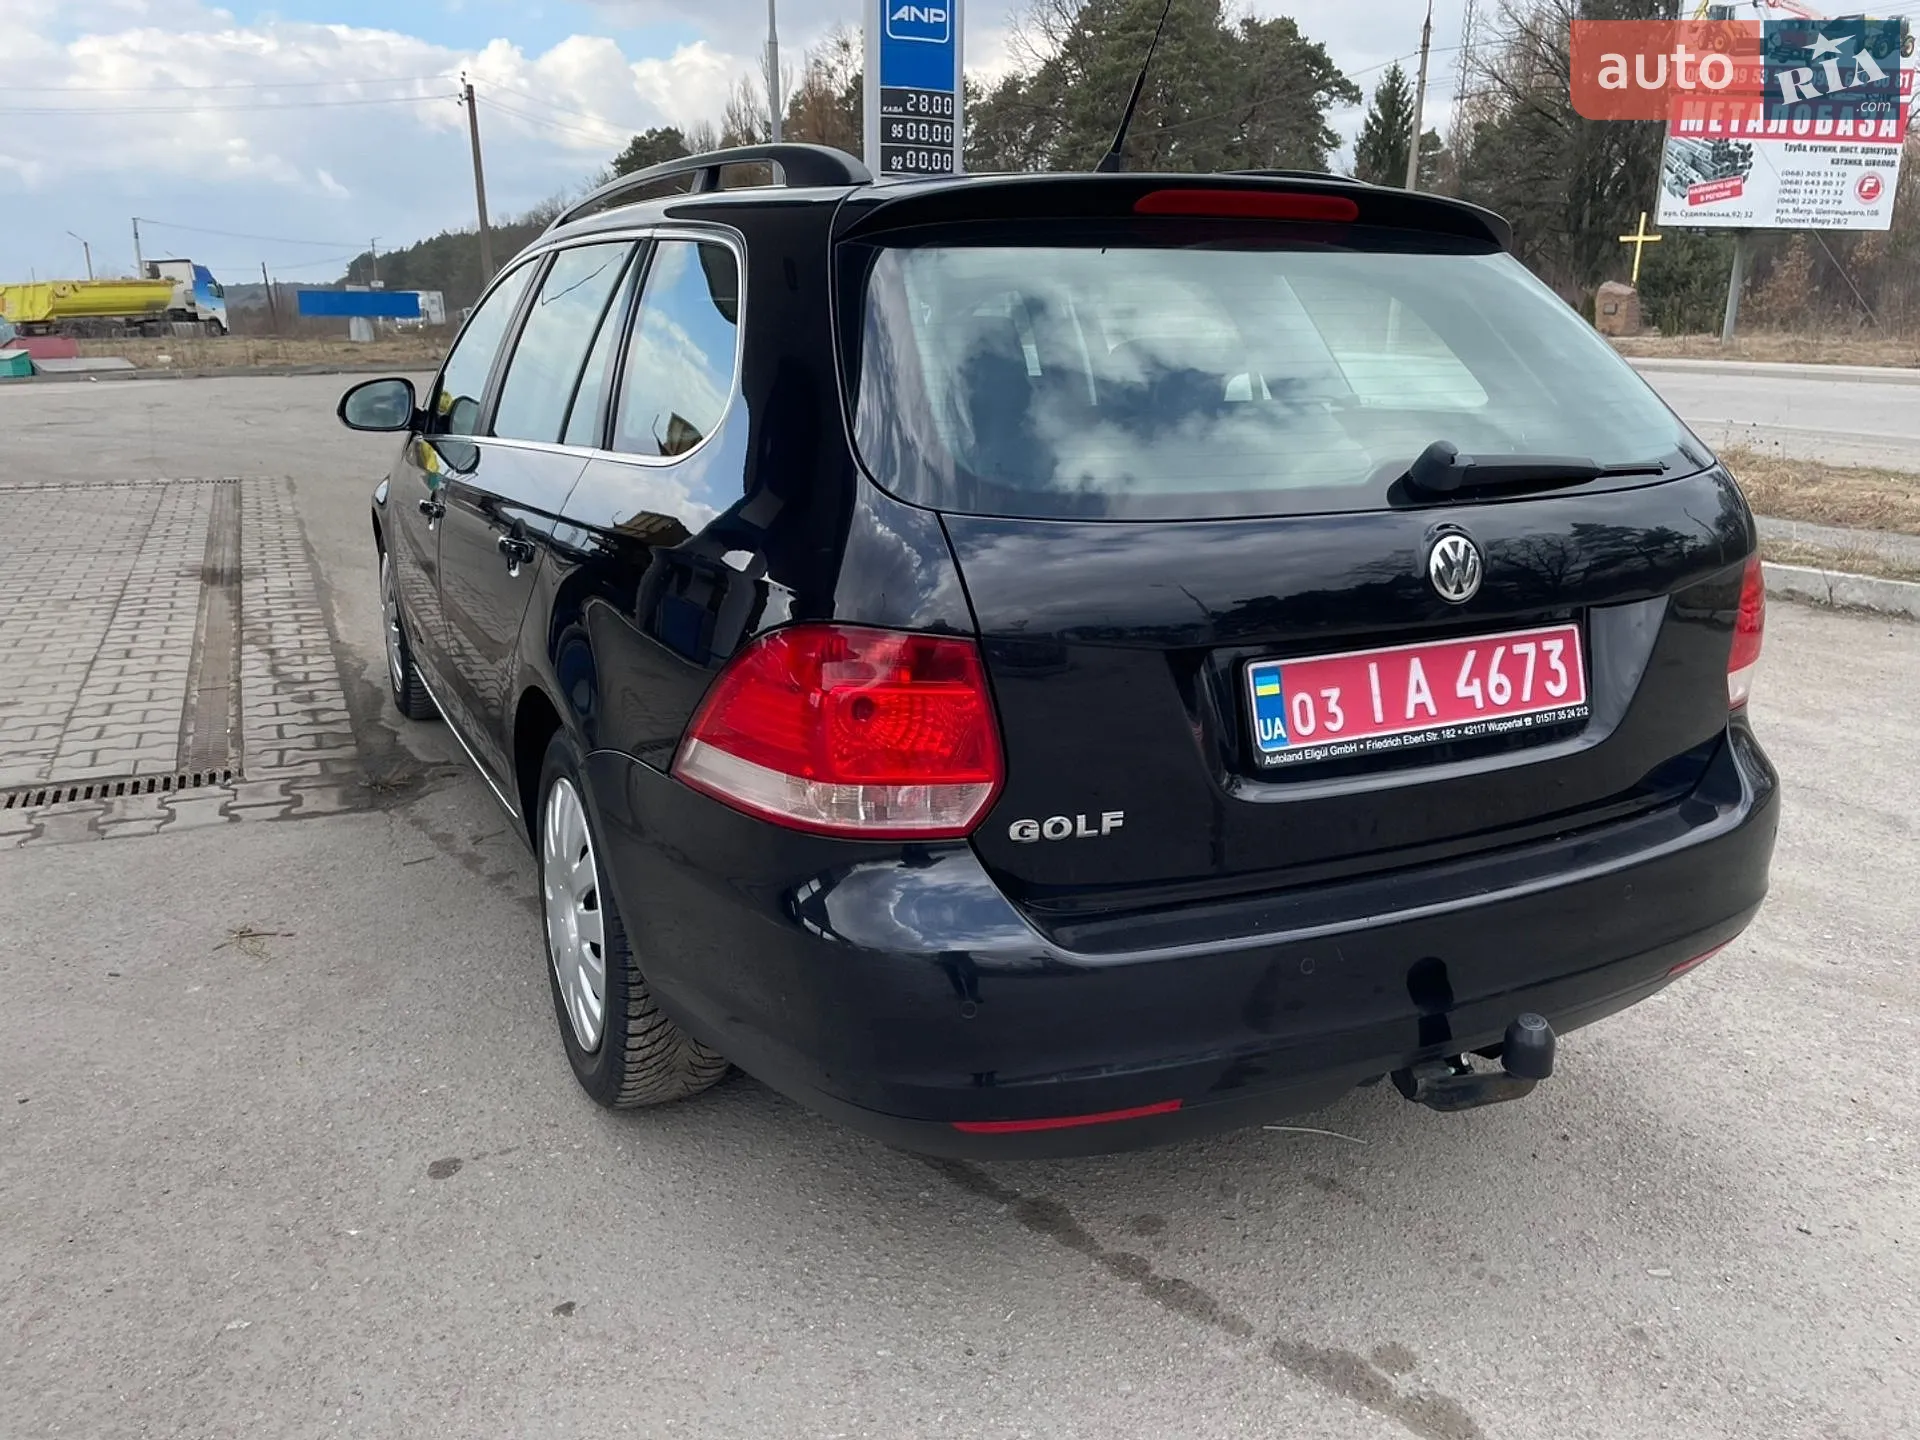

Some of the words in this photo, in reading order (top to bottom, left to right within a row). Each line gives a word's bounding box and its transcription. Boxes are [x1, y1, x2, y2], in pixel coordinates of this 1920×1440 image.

[890, 4, 947, 24] ANP
[906, 94, 952, 115] 28.00
[1679, 99, 1898, 138] МЕТАЛОБАЗА
[890, 123, 903, 138] 95
[906, 122, 952, 143] 00.00
[890, 155, 903, 170] 92
[906, 150, 952, 171] 00.00
[1291, 686, 1345, 737] 03
[1455, 638, 1568, 710] 4673
[1258, 715, 1287, 742] UA
[1264, 752, 1303, 766] Autoland
[1330, 742, 1358, 756] GmbH
[1365, 736, 1402, 751] Friedrich
[1403, 732, 1425, 746] Ebert
[1441, 728, 1456, 740] 182
[1487, 717, 1523, 733] Wuppertal
[1008, 810, 1125, 844] GOLF
